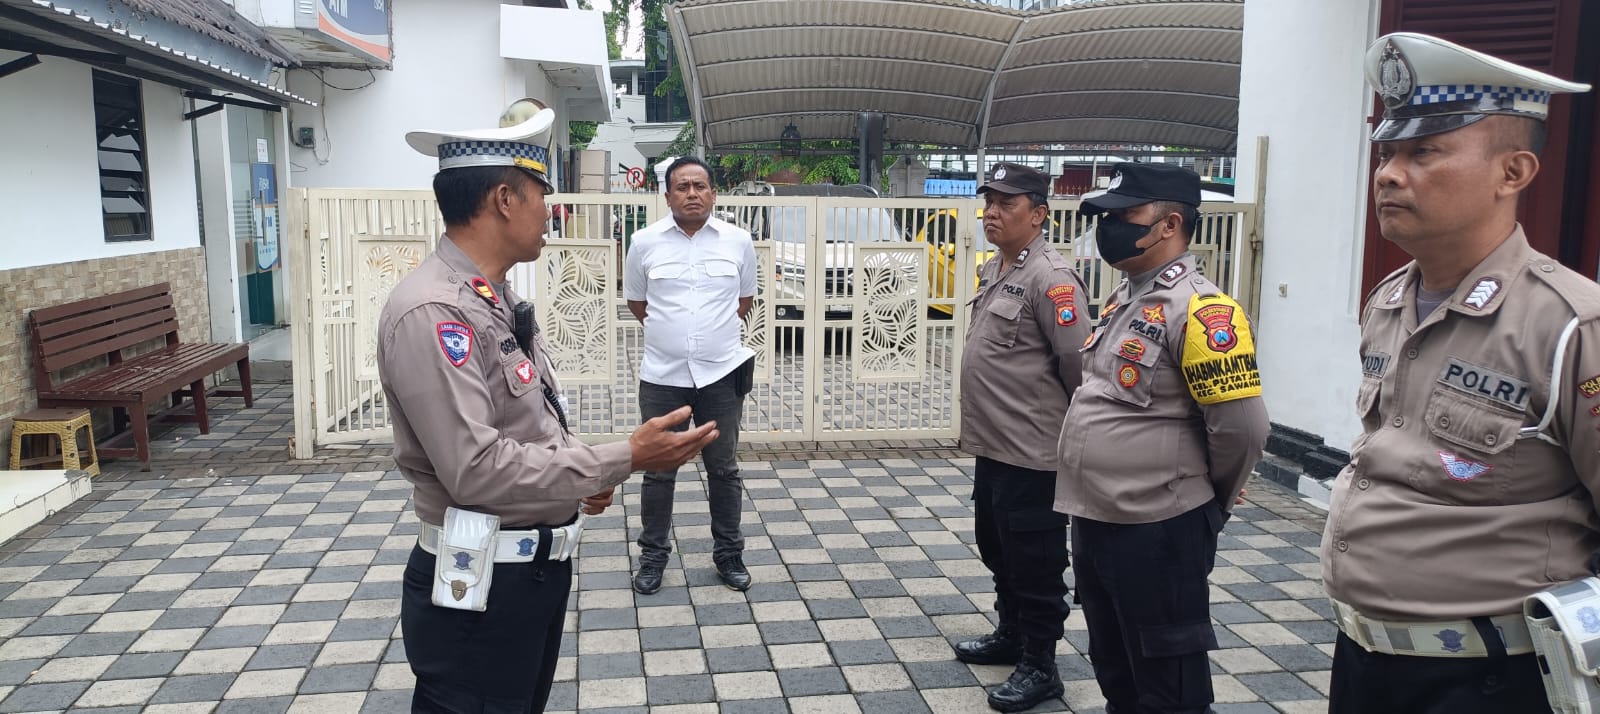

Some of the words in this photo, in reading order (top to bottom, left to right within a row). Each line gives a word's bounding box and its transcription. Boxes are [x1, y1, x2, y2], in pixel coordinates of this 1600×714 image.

[632, 170, 640, 183] P
[1002, 284, 1025, 297] POLRI
[1129, 319, 1163, 340] POLRI
[1362, 356, 1385, 373] UDI
[1212, 374, 1248, 387] PUTAT
[1444, 364, 1528, 405] POLRI
